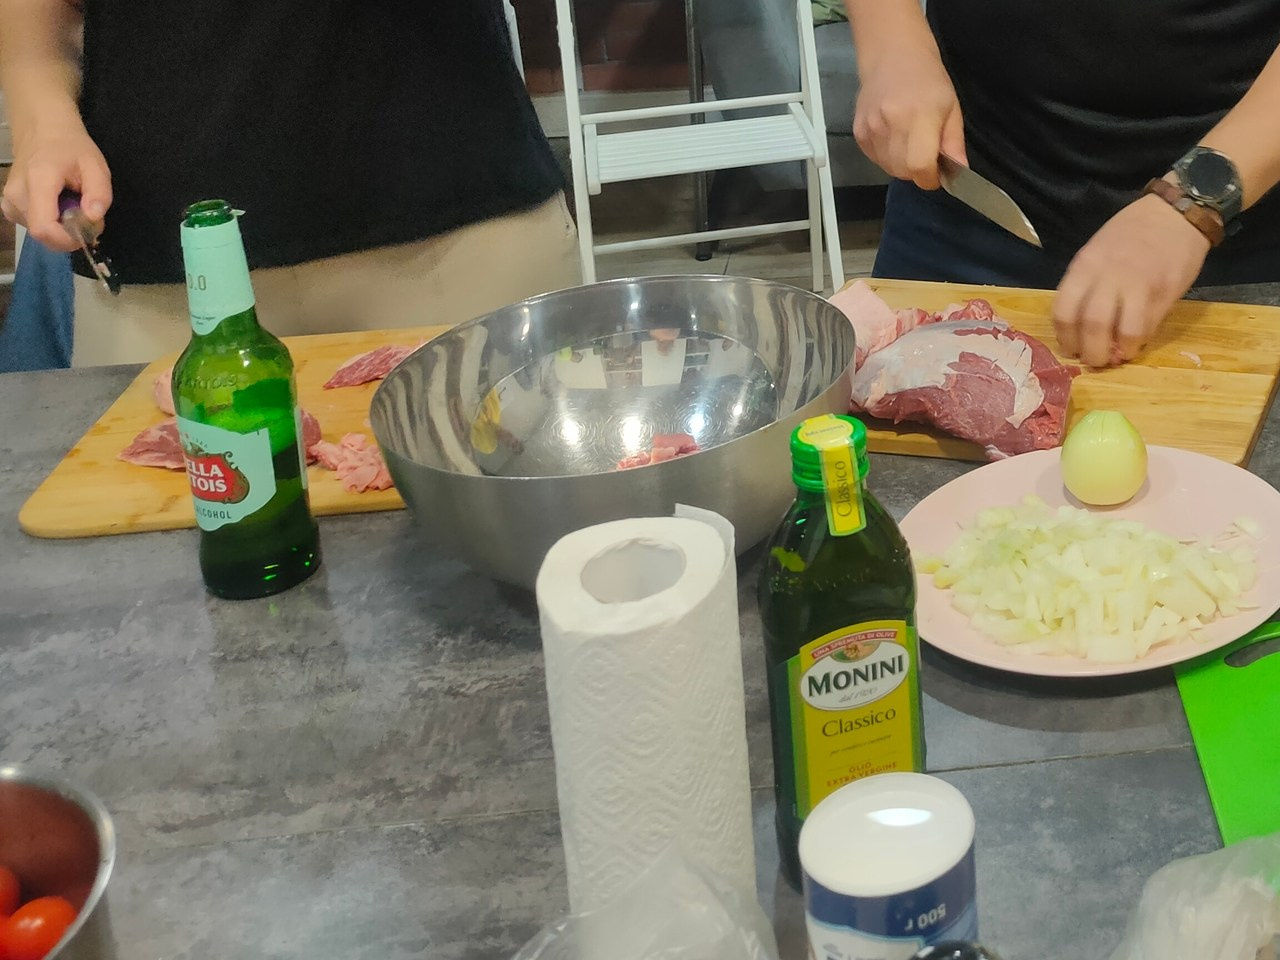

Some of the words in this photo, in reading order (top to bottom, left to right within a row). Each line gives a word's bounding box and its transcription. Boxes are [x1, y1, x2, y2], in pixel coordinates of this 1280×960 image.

[835, 460, 852, 517] Classico
[808, 654, 904, 697] MONINI
[822, 708, 896, 737] Classico
[827, 774, 857, 787] EXTRA
[859, 762, 897, 777] VERGINE
[849, 762, 872, 773] OLIO
[918, 903, 946, 929] 500
